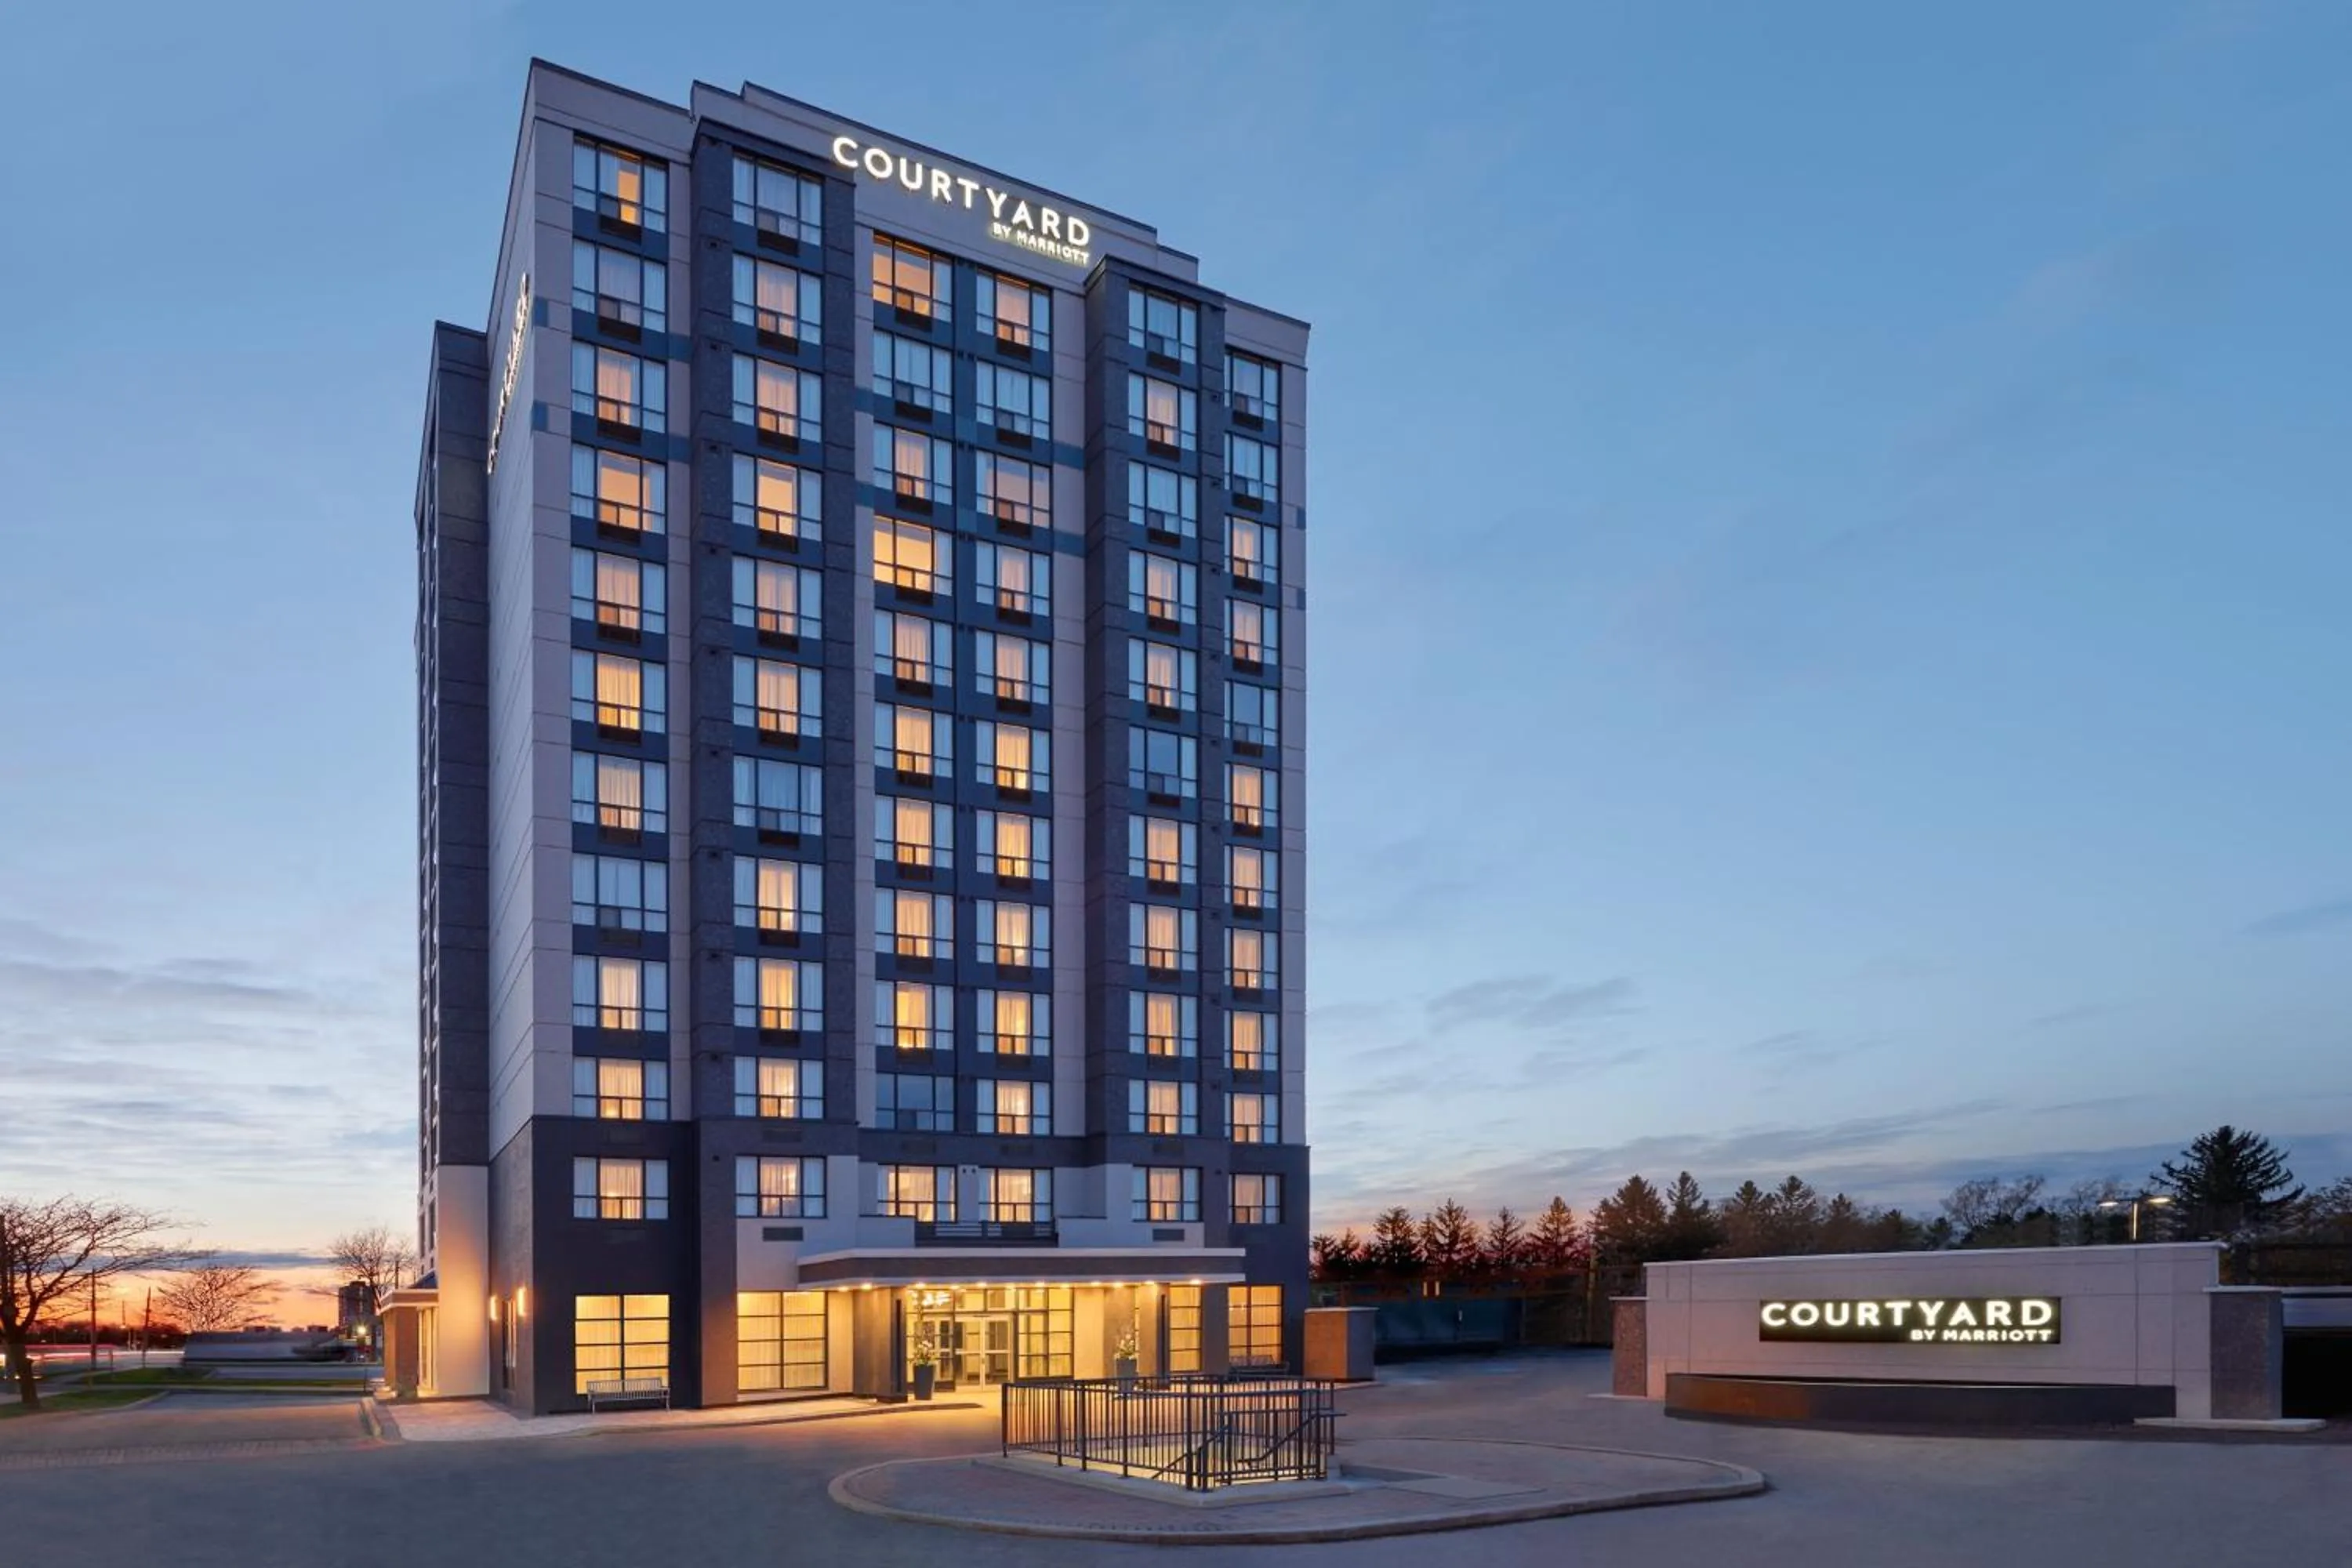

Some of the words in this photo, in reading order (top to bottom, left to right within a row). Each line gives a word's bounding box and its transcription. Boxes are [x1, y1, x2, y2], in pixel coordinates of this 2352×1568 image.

[833, 136, 1091, 246] COURTYARD
[993, 222, 1012, 239] BY
[1016, 230, 1091, 265] MARRIOTT
[1761, 1300, 2053, 1327] COURTYARD
[1910, 1329, 1936, 1341] BY
[1943, 1329, 2053, 1341] MARRIOTT
